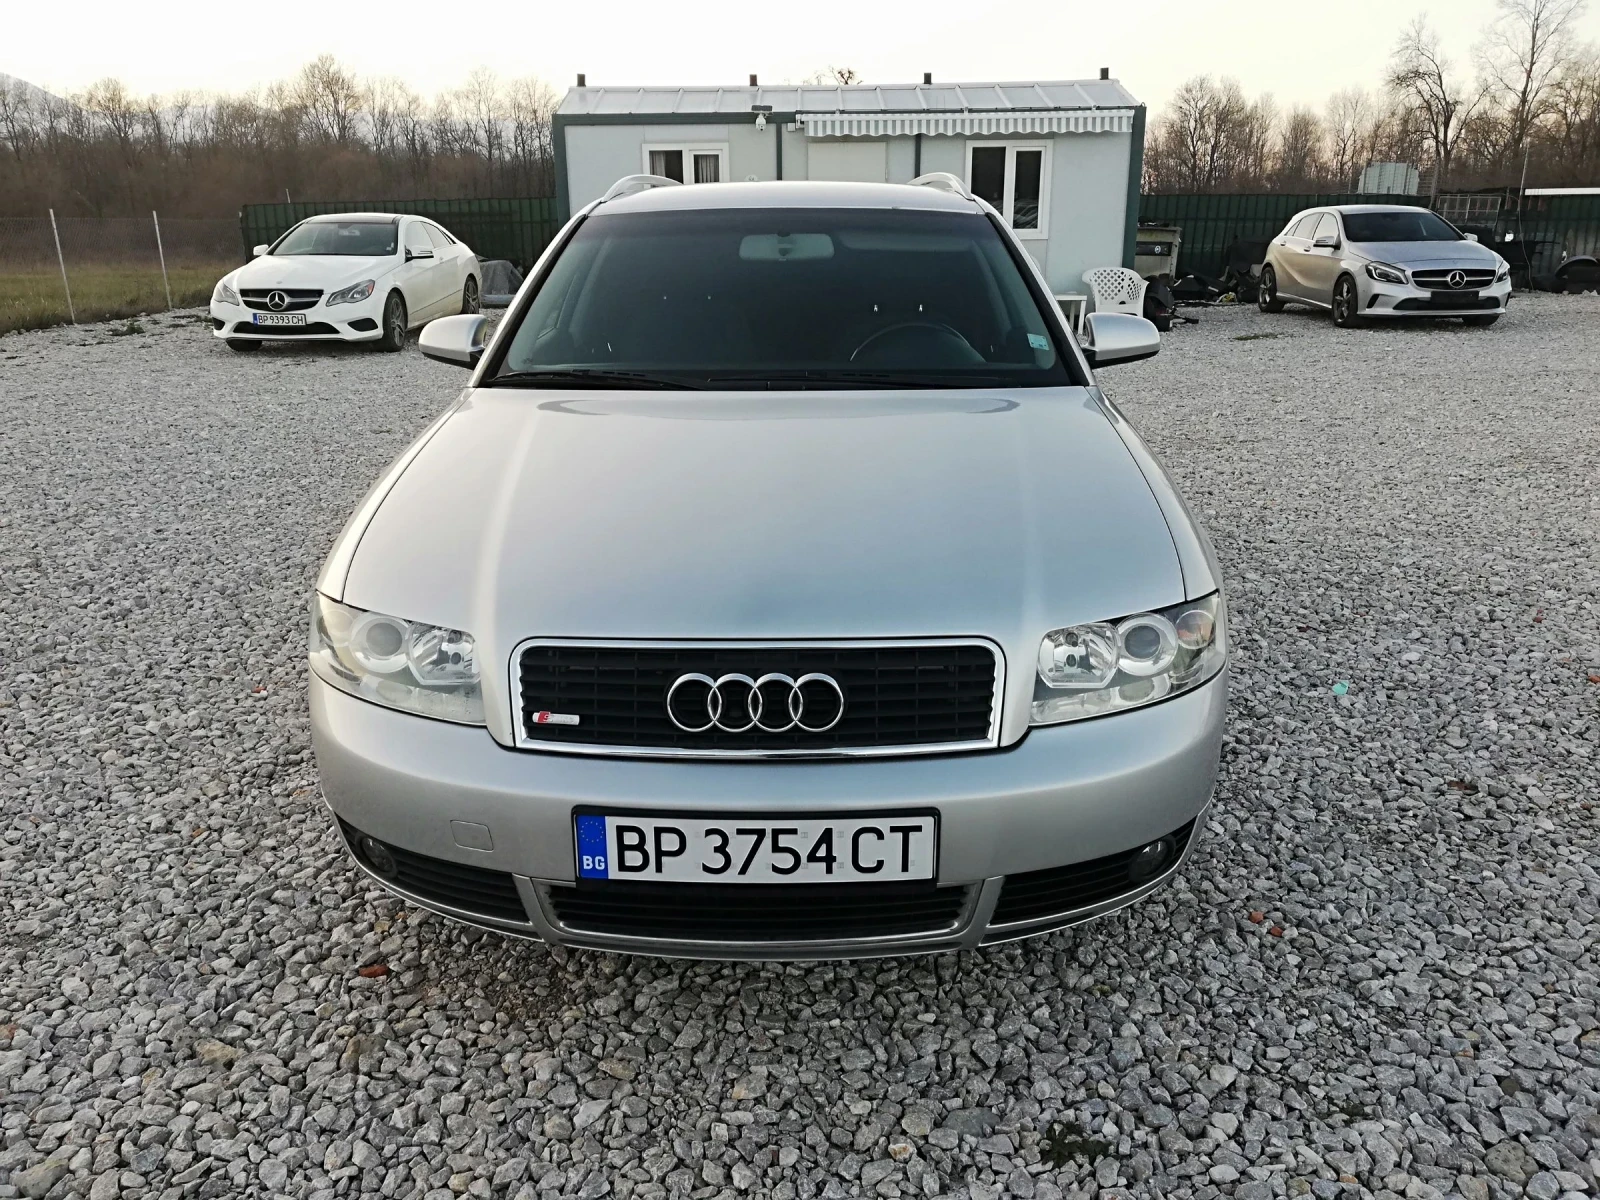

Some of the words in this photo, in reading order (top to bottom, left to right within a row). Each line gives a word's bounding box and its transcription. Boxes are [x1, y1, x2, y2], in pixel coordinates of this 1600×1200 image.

[258, 315, 268, 324] BP
[270, 315, 290, 324] 9393
[291, 315, 304, 325] CH
[615, 824, 687, 874] BP
[702, 827, 837, 876] 3754
[851, 825, 923, 874] CT
[582, 855, 605, 870] BG
